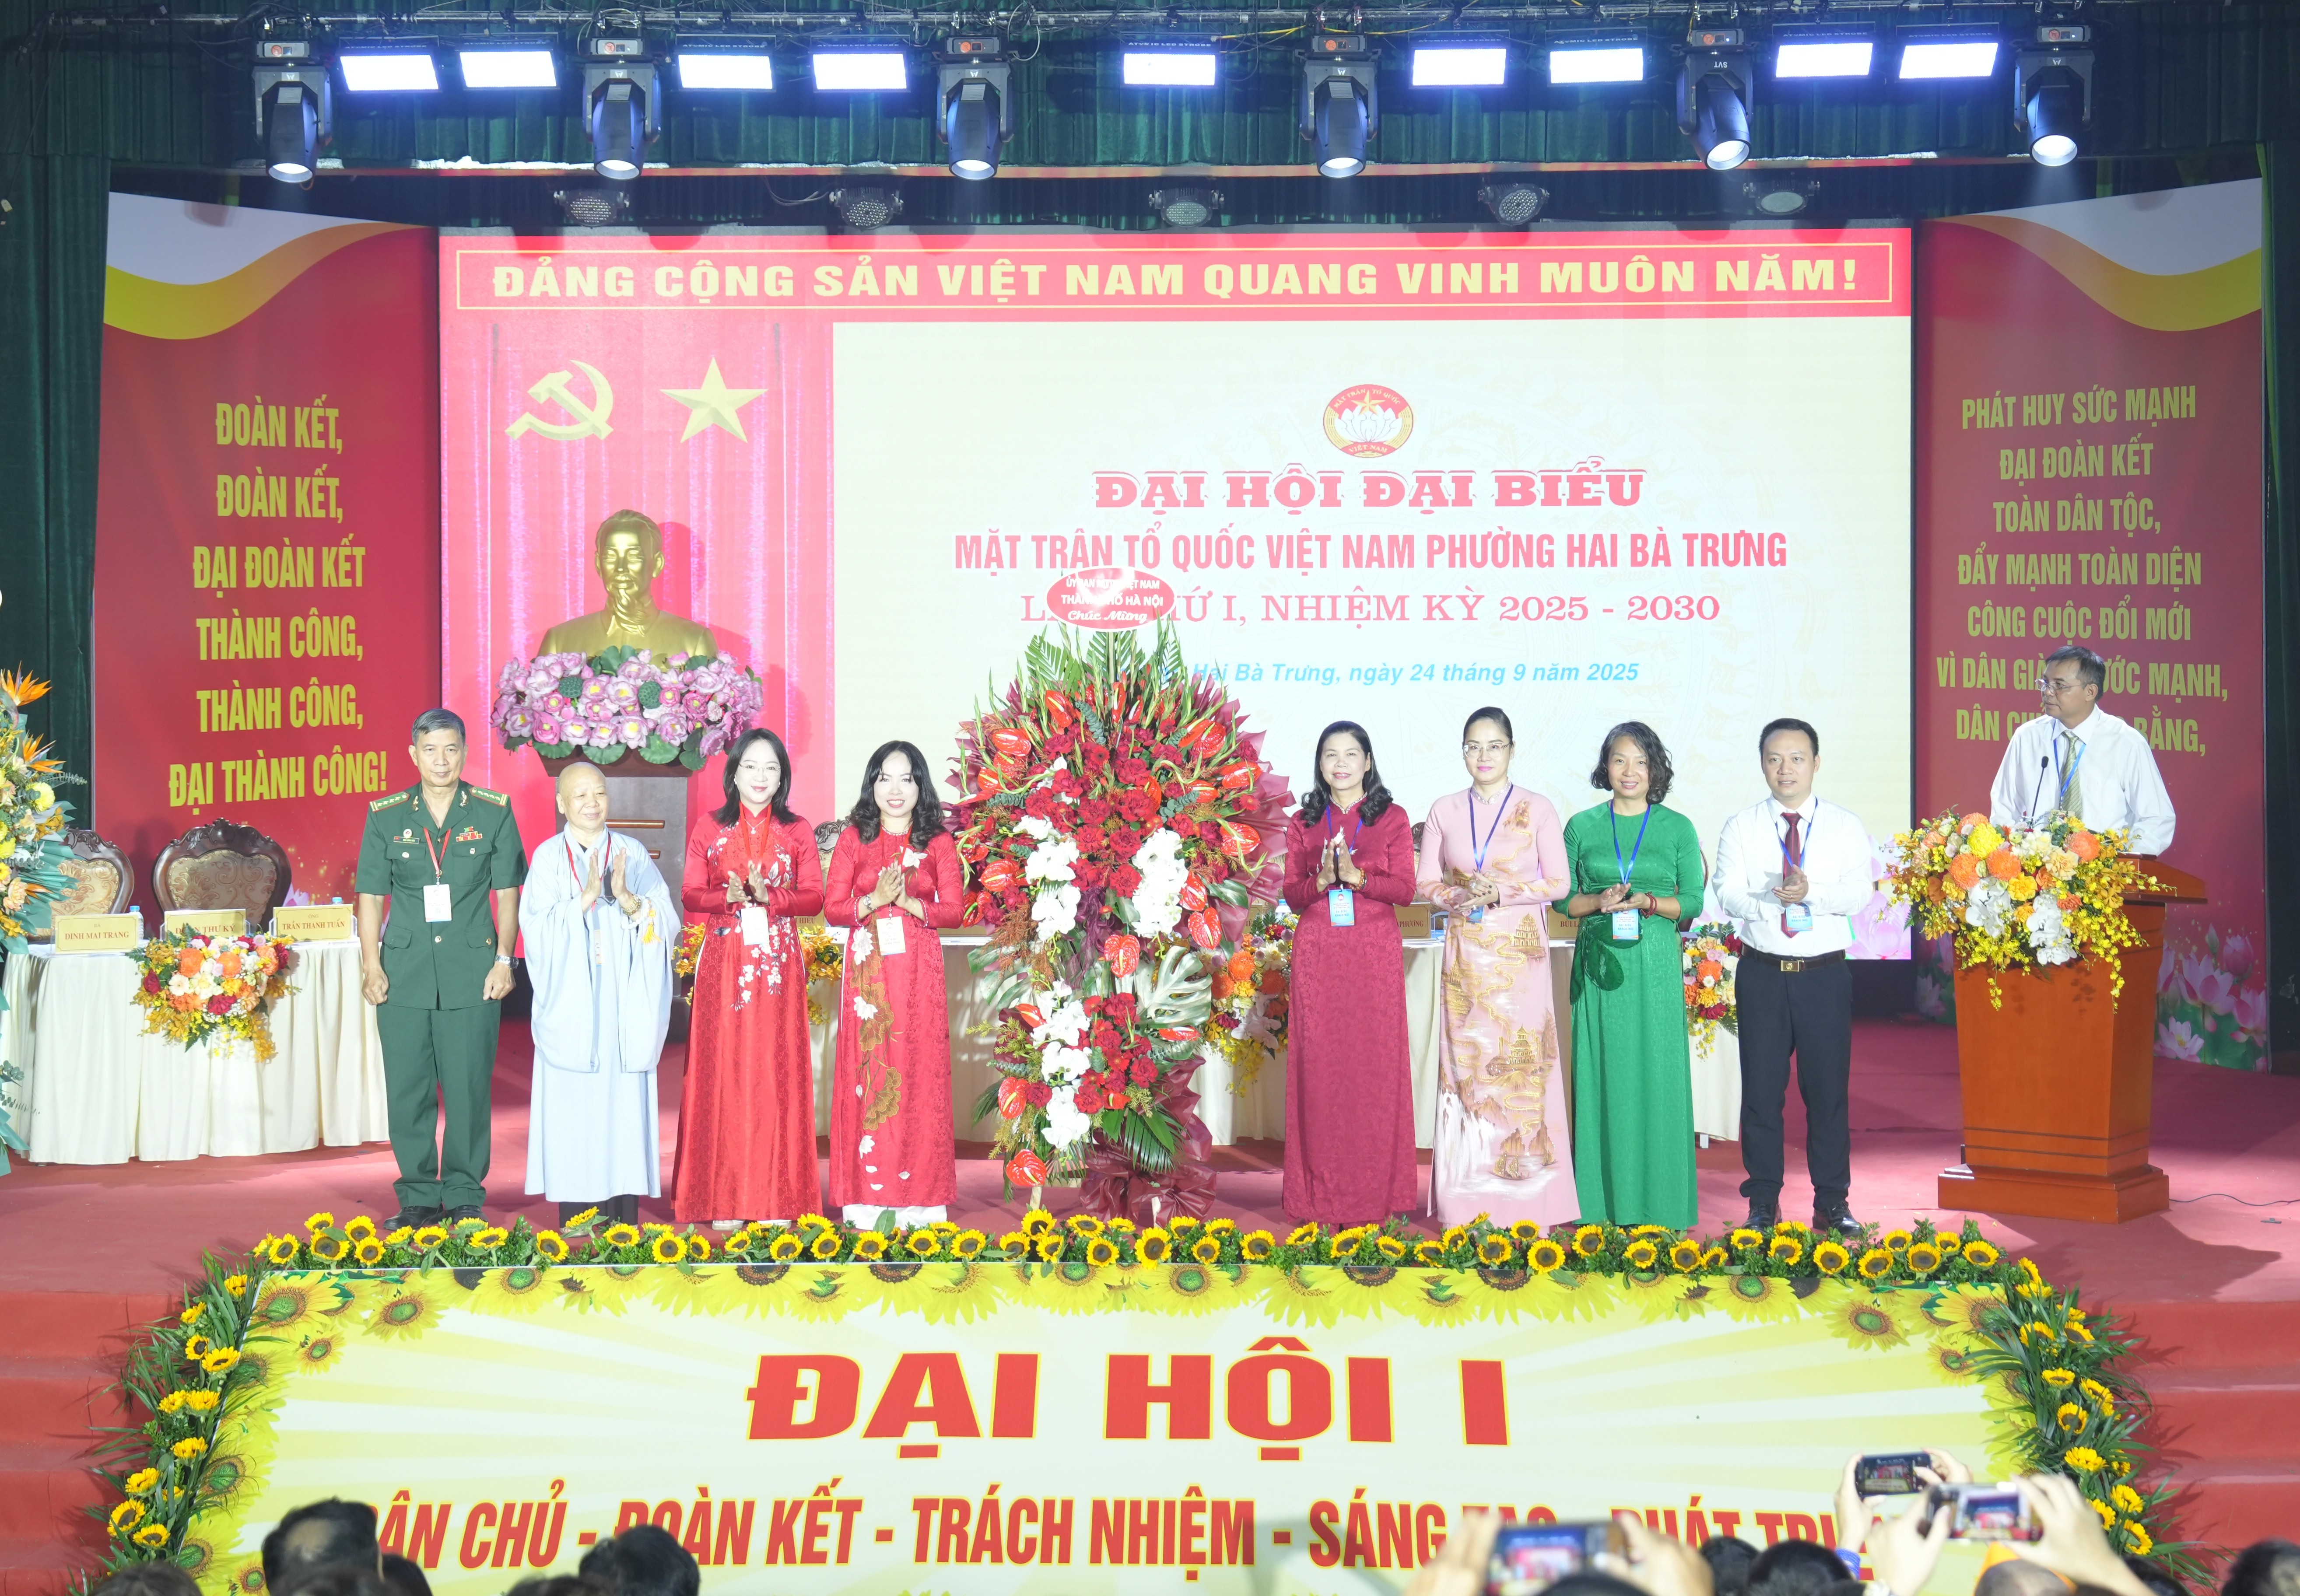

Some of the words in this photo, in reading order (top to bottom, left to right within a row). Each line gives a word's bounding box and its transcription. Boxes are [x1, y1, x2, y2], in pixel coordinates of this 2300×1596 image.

[493, 255, 635, 298] ĐẢNG
[659, 259, 794, 304] CỘNG
[813, 255, 919, 298] SẢN
[937, 259, 1048, 302] VIỆT
[1066, 264, 1184, 296] NAM
[1203, 263, 1378, 296] QUANG
[1397, 262, 1518, 294] VINH
[1539, 255, 1695, 293] MUÔN
[1715, 253, 1856, 291] NĂM!
[216, 396, 286, 447] ĐOÀN
[295, 394, 342, 454] KẾT,
[1963, 391, 2016, 429] PHÁT
[2023, 393, 2065, 426] HUY
[2072, 384, 2117, 424] SỨC
[2126, 385, 2195, 427] MẠNH
[1093, 471, 1206, 515] ĐẠI
[1224, 464, 1345, 515] HỘI
[1360, 471, 1473, 514] ĐẠI
[1491, 456, 1646, 507] BIỂU
[2000, 448, 2035, 486] ĐẠI
[2043, 439, 2103, 478] ĐOÀN
[2112, 433, 2153, 476] KẾT
[217, 466, 287, 517] ĐOÀN
[295, 464, 343, 523] KẾT,
[1993, 494, 2049, 532] TOÀN
[2058, 493, 2102, 531] DÂN
[2111, 491, 2160, 537] TỘC,
[193, 546, 236, 598] ĐẠI
[245, 538, 313, 588] ĐOÀN
[322, 533, 365, 587] KẾT
[955, 528, 1020, 576] MẶT
[1123, 521, 1162, 568] TỔ
[1172, 523, 1254, 573] QUỐC
[1266, 528, 1331, 576] VIỆT
[1343, 534, 1414, 568] NAM
[1427, 526, 1554, 569] PHƯỜNG
[1567, 533, 1617, 567] HAI
[1630, 526, 1676, 567] BÀ
[1683, 529, 1787, 567] TRƯNG
[1958, 542, 1998, 584] ĐẨY
[2006, 554, 2071, 592] MẠNH
[2079, 546, 2138, 584] TOÀN
[2146, 545, 2201, 592] DIỆN
[1125, 594, 1141, 606] HÀ
[1143, 594, 1163, 608] NỘI
[1140, 580, 1160, 589] NAM
[1223, 595, 1246, 626] I,
[1261, 586, 1409, 629] NHIỆM
[1423, 585, 1485, 621] KỲ
[1499, 596, 1588, 622] 2025
[1627, 595, 1720, 621] 2030
[196, 609, 281, 660] THÀNH
[290, 607, 363, 661] CÔNG,
[1068, 610, 1101, 620] Chúc
[1104, 611, 1147, 624] Mừng
[1968, 599, 2025, 637] CÔNG
[2034, 600, 2092, 645] CUỘC
[2099, 595, 2137, 639] ĐỔI
[2146, 601, 2191, 640] MỚI
[1235, 663, 1263, 681] Bà
[1272, 663, 1340, 686] Trưng,
[1349, 663, 1403, 686] ngày
[1410, 665, 1434, 681] 24
[1443, 663, 1507, 686] tháng
[1515, 664, 1526, 681] 9
[1532, 663, 1580, 681] năm
[1588, 663, 1639, 681] 2025
[1937, 651, 1955, 687] VÌ
[1963, 652, 2006, 689] DÂN
[2149, 663, 2228, 703] MẠNH,
[196, 680, 281, 732] THÀNH
[290, 677, 363, 729] CÔNG,
[1956, 704, 1999, 741] DÂN
[2134, 705, 2205, 756] BẰNG,
[169, 762, 213, 815] ĐẠI
[222, 750, 305, 802] THÀNH
[313, 745, 386, 796] CÔNG!
[744, 1350, 1041, 1460] ĐẠI
[1102, 1336, 1395, 1462] HỘI
[1459, 1355, 1511, 1446] I
[370, 1490, 451, 1569] ÂN
[459, 1479, 568, 1569] CHỦ
[765, 1477, 863, 1564] KẾT
[912, 1484, 1073, 1566] TRÁCH
[1088, 1484, 1256, 1581] NHIỆM
[1308, 1488, 1447, 1570] SÁNG
